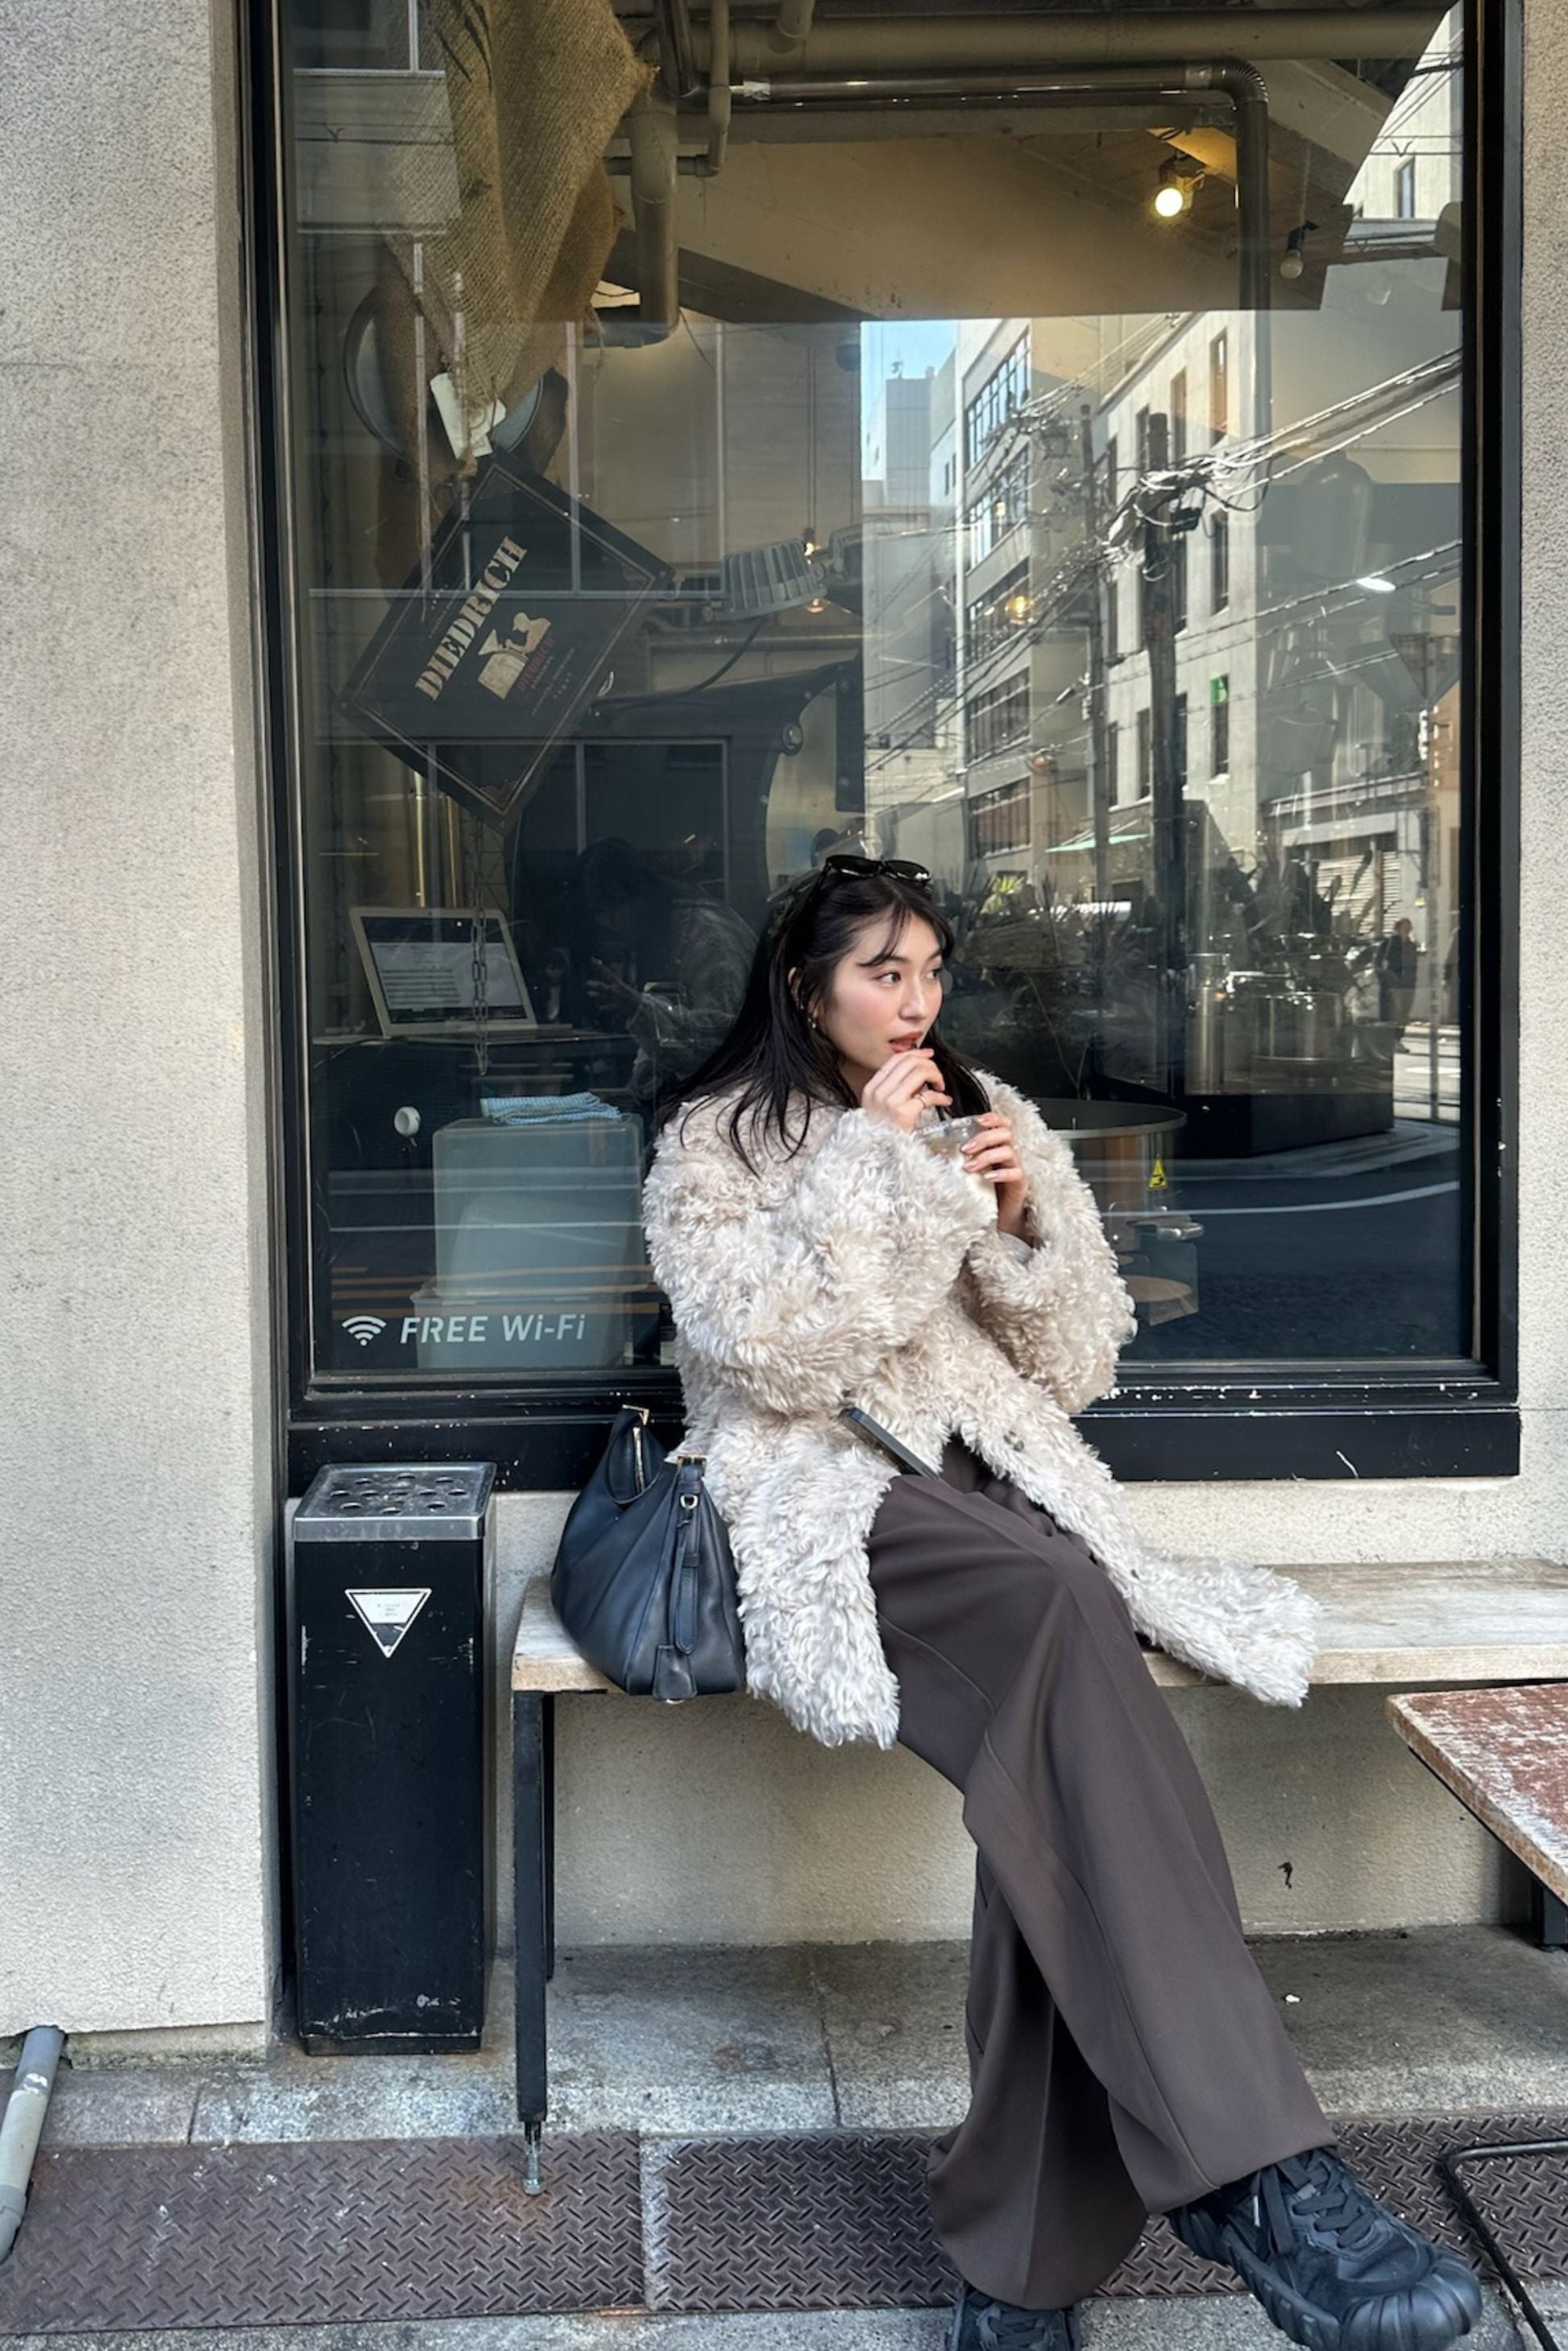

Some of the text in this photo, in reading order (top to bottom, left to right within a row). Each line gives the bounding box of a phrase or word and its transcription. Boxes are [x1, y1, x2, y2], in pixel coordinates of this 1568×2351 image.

[414, 536, 528, 700] DIEDRICH
[400, 1313, 586, 1344] FREE Wi-Fi
